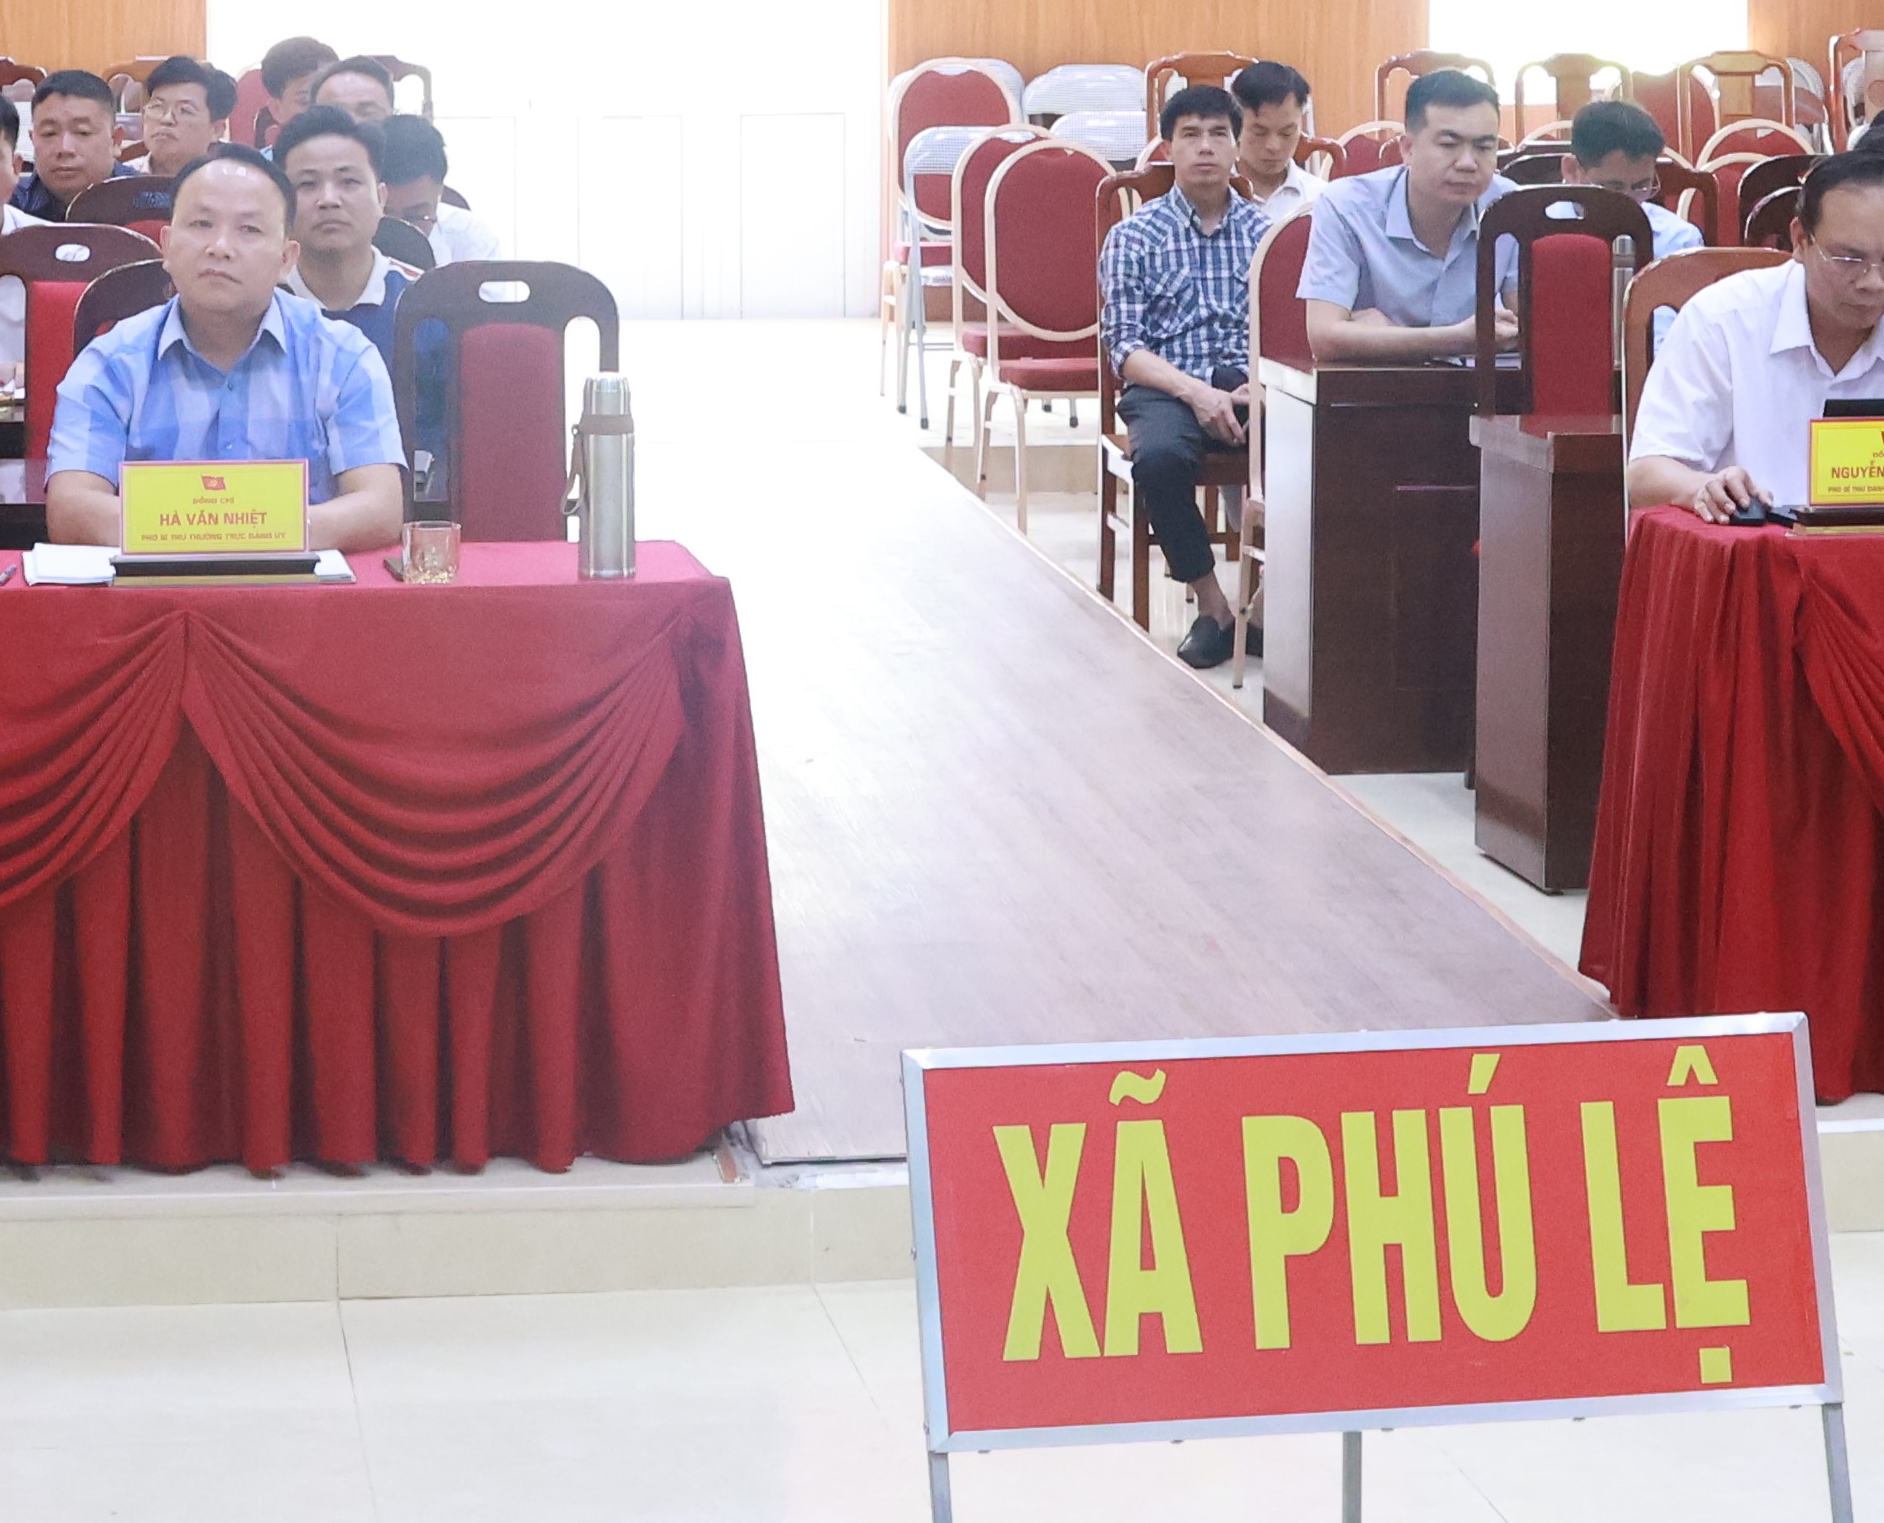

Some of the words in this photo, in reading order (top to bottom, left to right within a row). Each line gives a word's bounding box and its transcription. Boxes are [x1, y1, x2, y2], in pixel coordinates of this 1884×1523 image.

[1831, 460, 1884, 479] NGUYỄN
[159, 510, 181, 526] HÀ
[186, 509, 218, 526] VĂN
[224, 509, 267, 529] NHIỆT
[992, 1068, 1203, 1362] XÃ
[1242, 1053, 1538, 1351] PHÚ
[1581, 1045, 1750, 1384] LỆ
